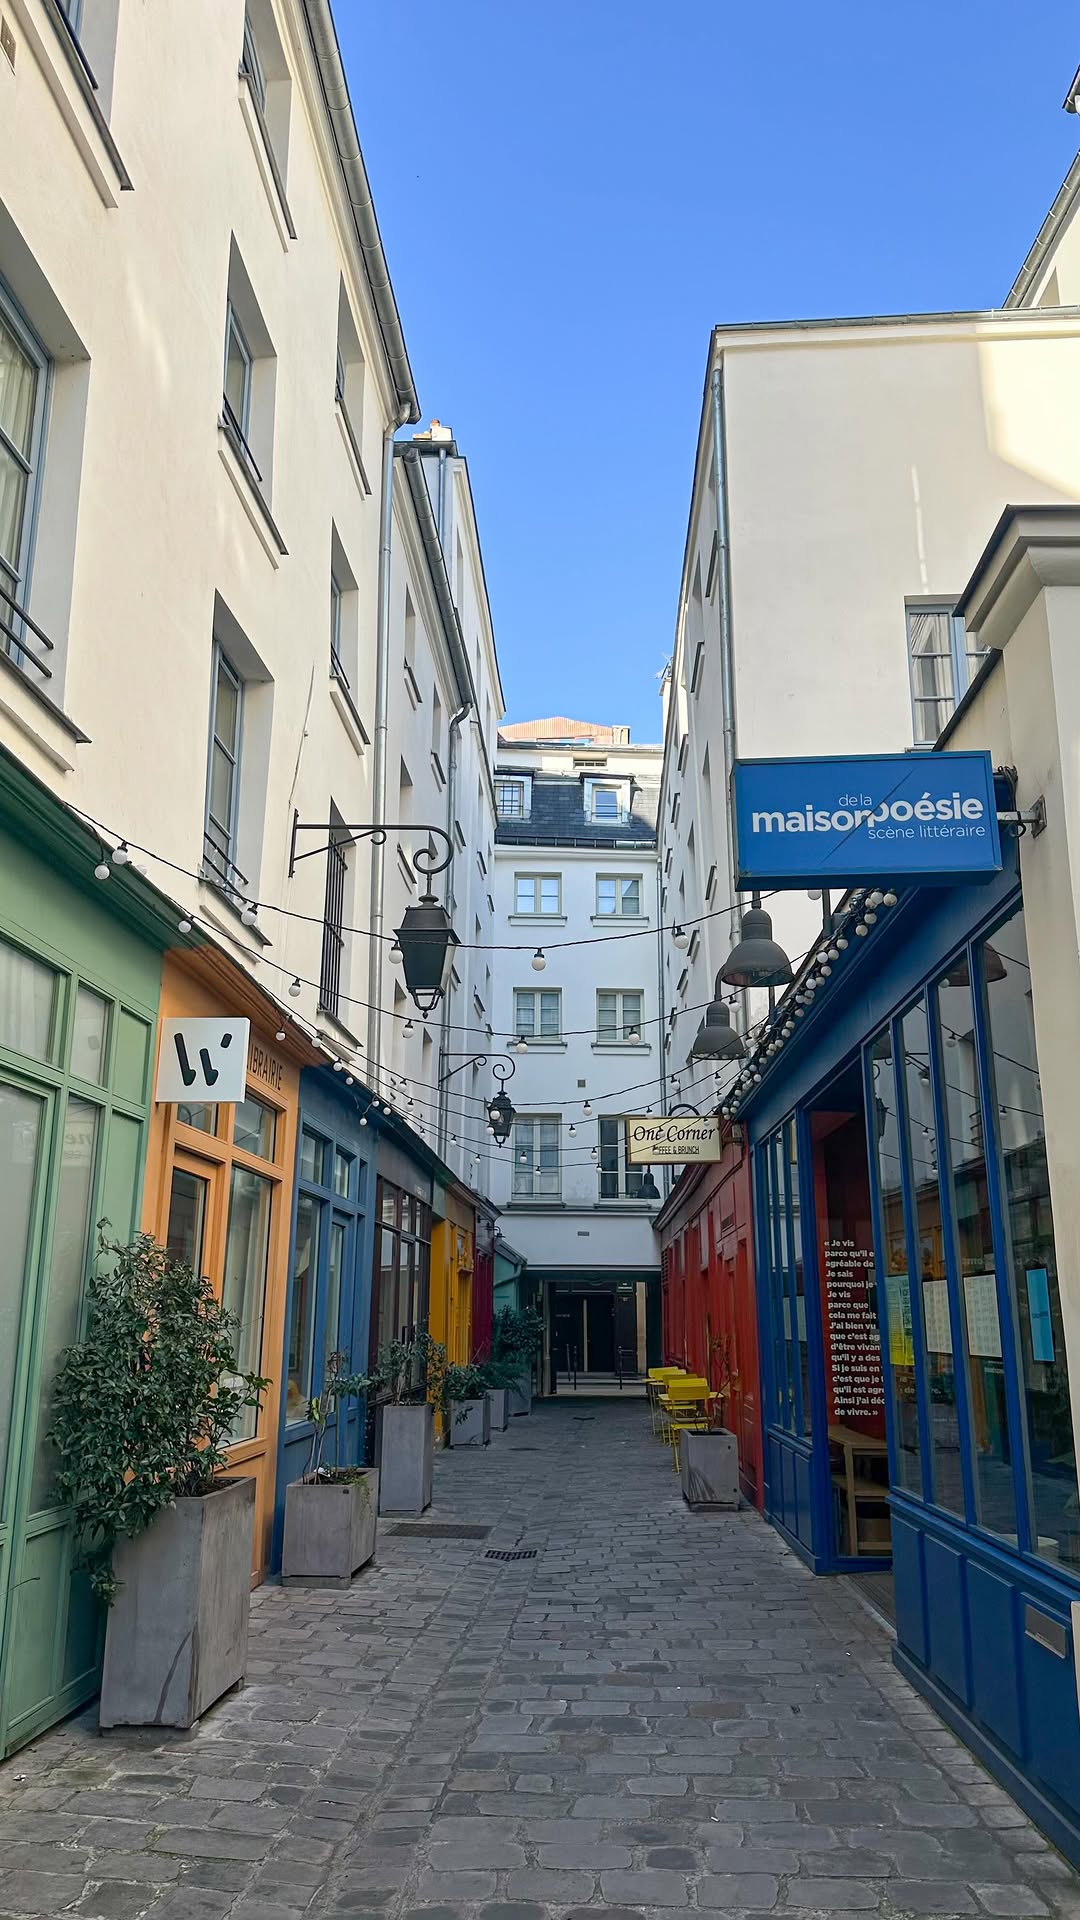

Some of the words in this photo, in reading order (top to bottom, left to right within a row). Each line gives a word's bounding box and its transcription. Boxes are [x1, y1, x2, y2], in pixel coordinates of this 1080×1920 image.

[839, 794, 857, 807] de
[860, 793, 872, 806] la
[752, 804, 875, 833] maison
[868, 792, 983, 827] poésie
[868, 827, 914, 839] scène
[920, 824, 985, 837] littéraire
[247, 1043, 282, 1091] IBRAIRIE
[667, 1126, 715, 1142] Corner
[653, 1146, 671, 1154] FFEE
[678, 1146, 699, 1154] BRUNCH
[826, 1260, 861, 1268] agréable
[872, 1376, 879, 1384] je
